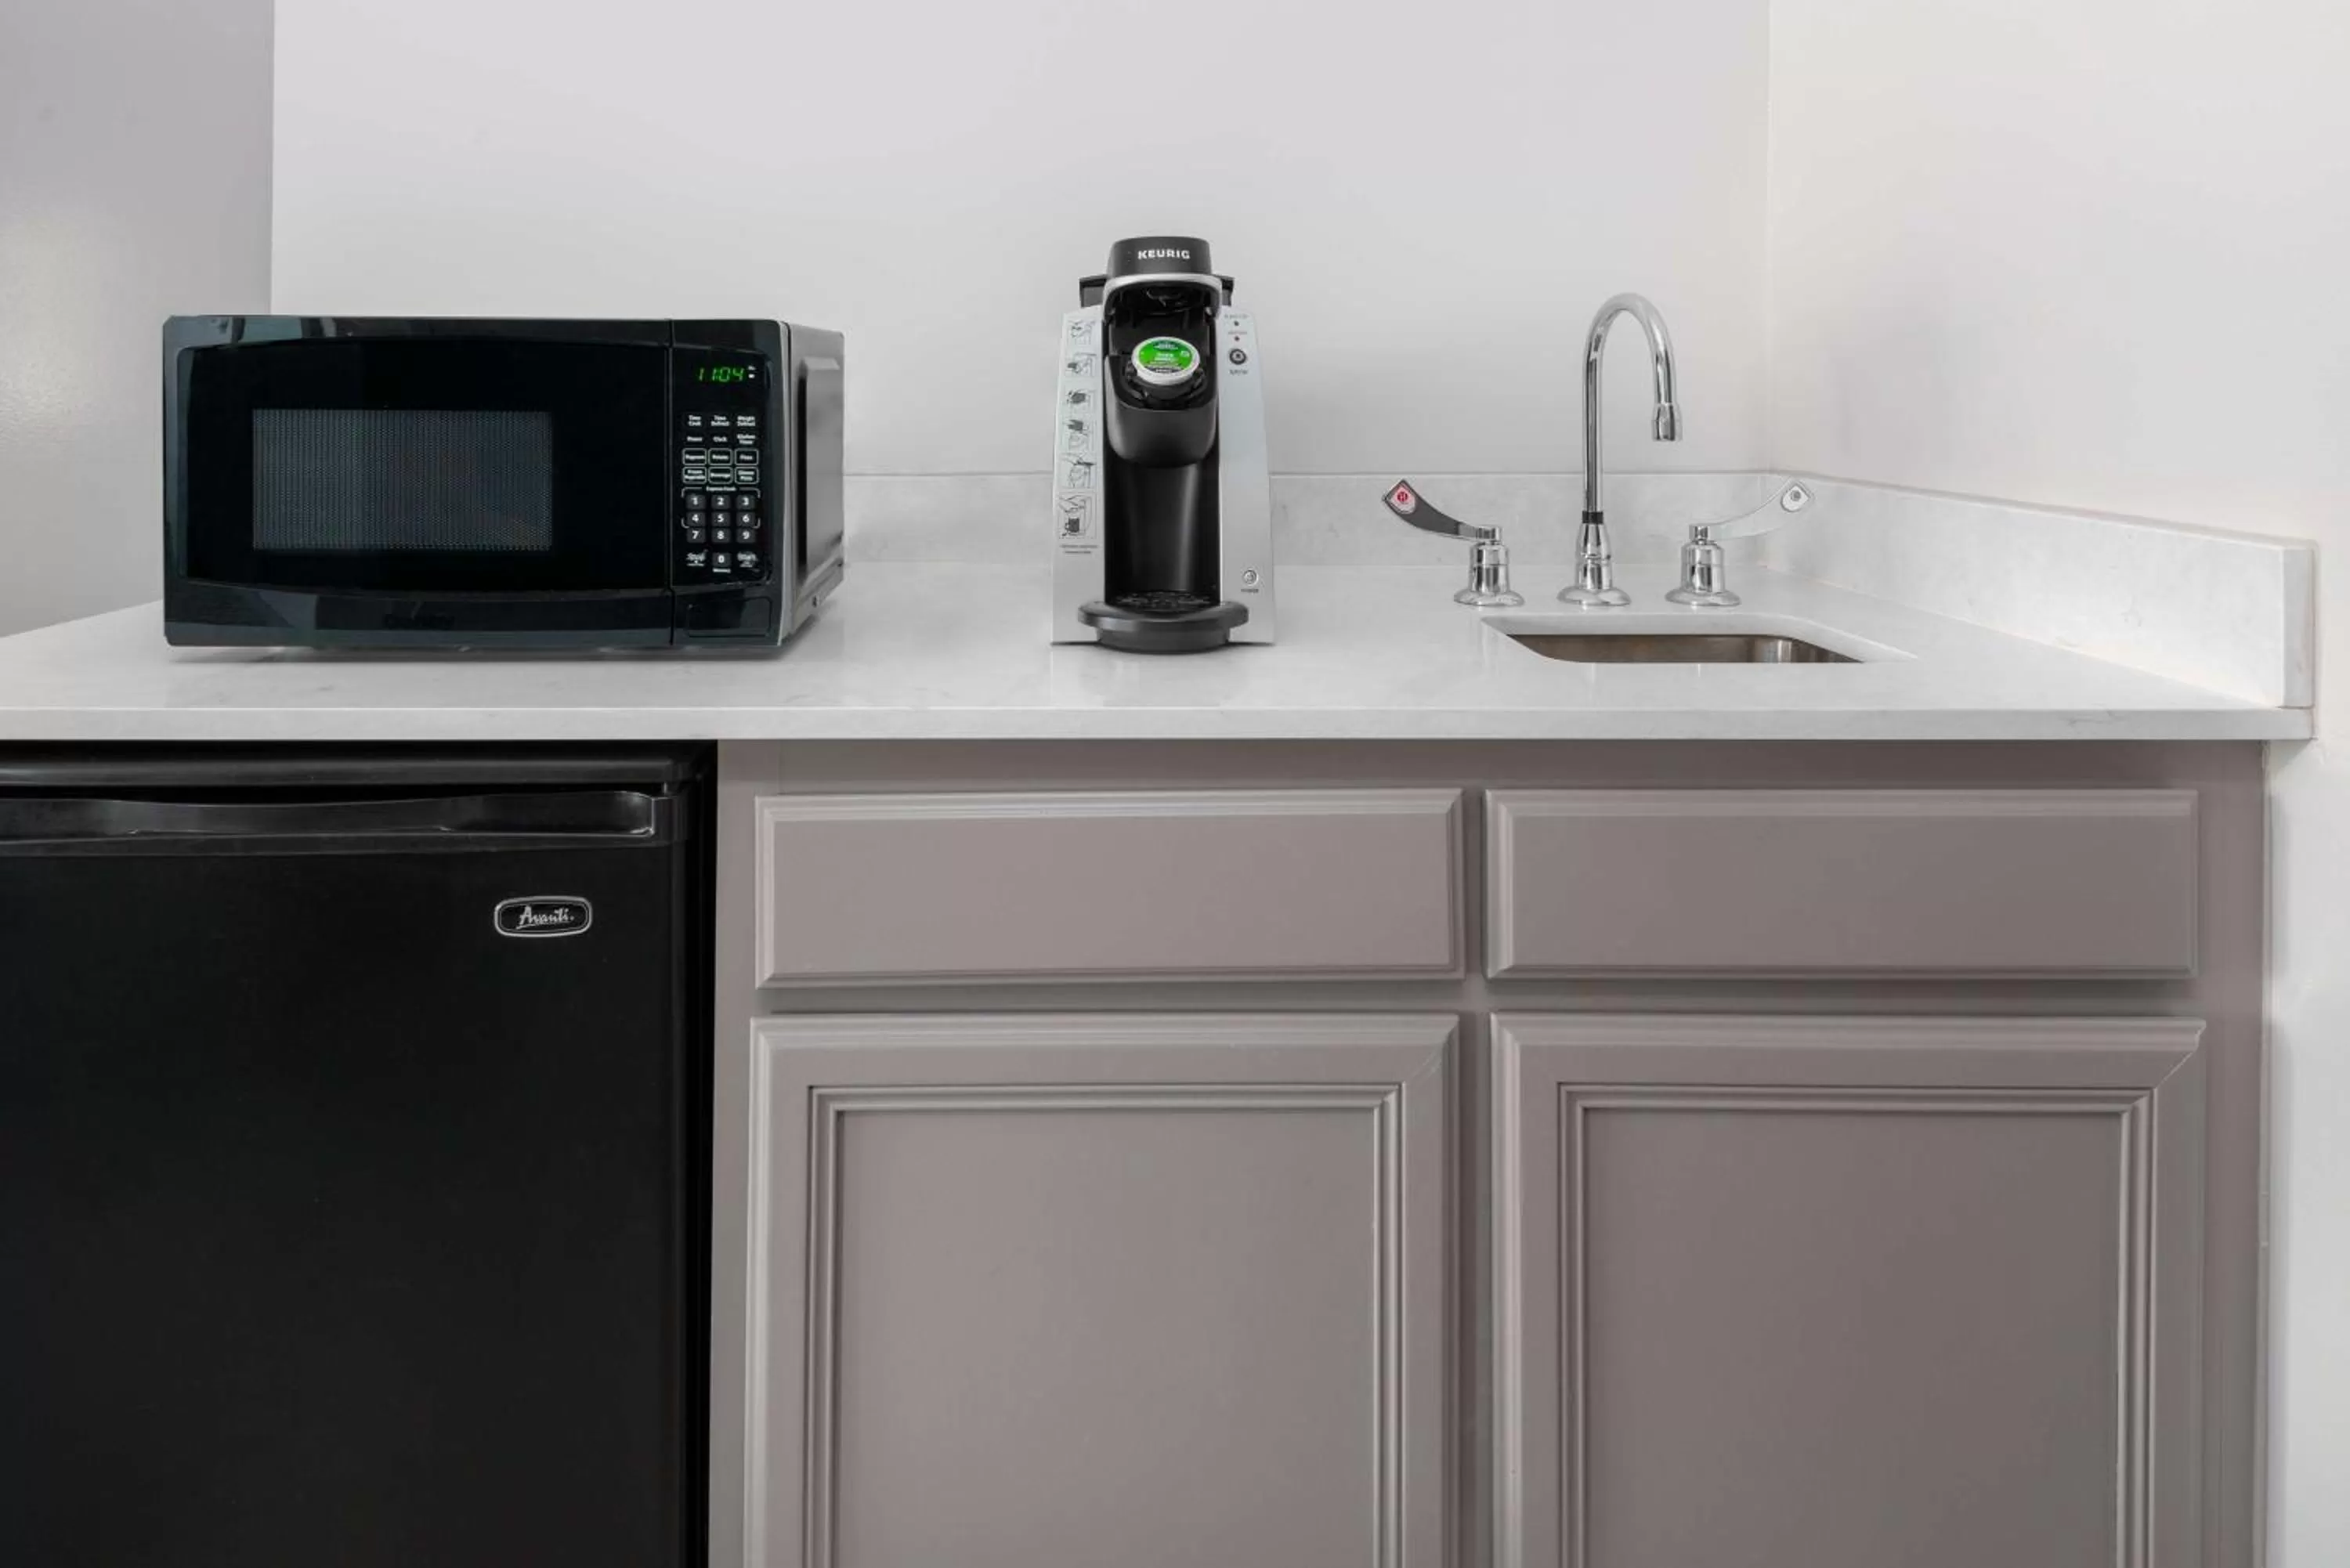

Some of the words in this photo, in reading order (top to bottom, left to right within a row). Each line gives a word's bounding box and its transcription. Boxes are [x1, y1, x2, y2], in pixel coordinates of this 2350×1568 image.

[1137, 248, 1191, 260] KEURIG
[691, 497, 699, 506] 1
[717, 497, 725, 506] 2
[742, 497, 750, 506] 3
[692, 514, 700, 522] 4
[717, 513, 725, 523] 5
[742, 514, 750, 523] 6
[692, 530, 700, 540] 7
[717, 530, 725, 540] 8
[742, 530, 750, 540] 9
[718, 554, 725, 564] 0
